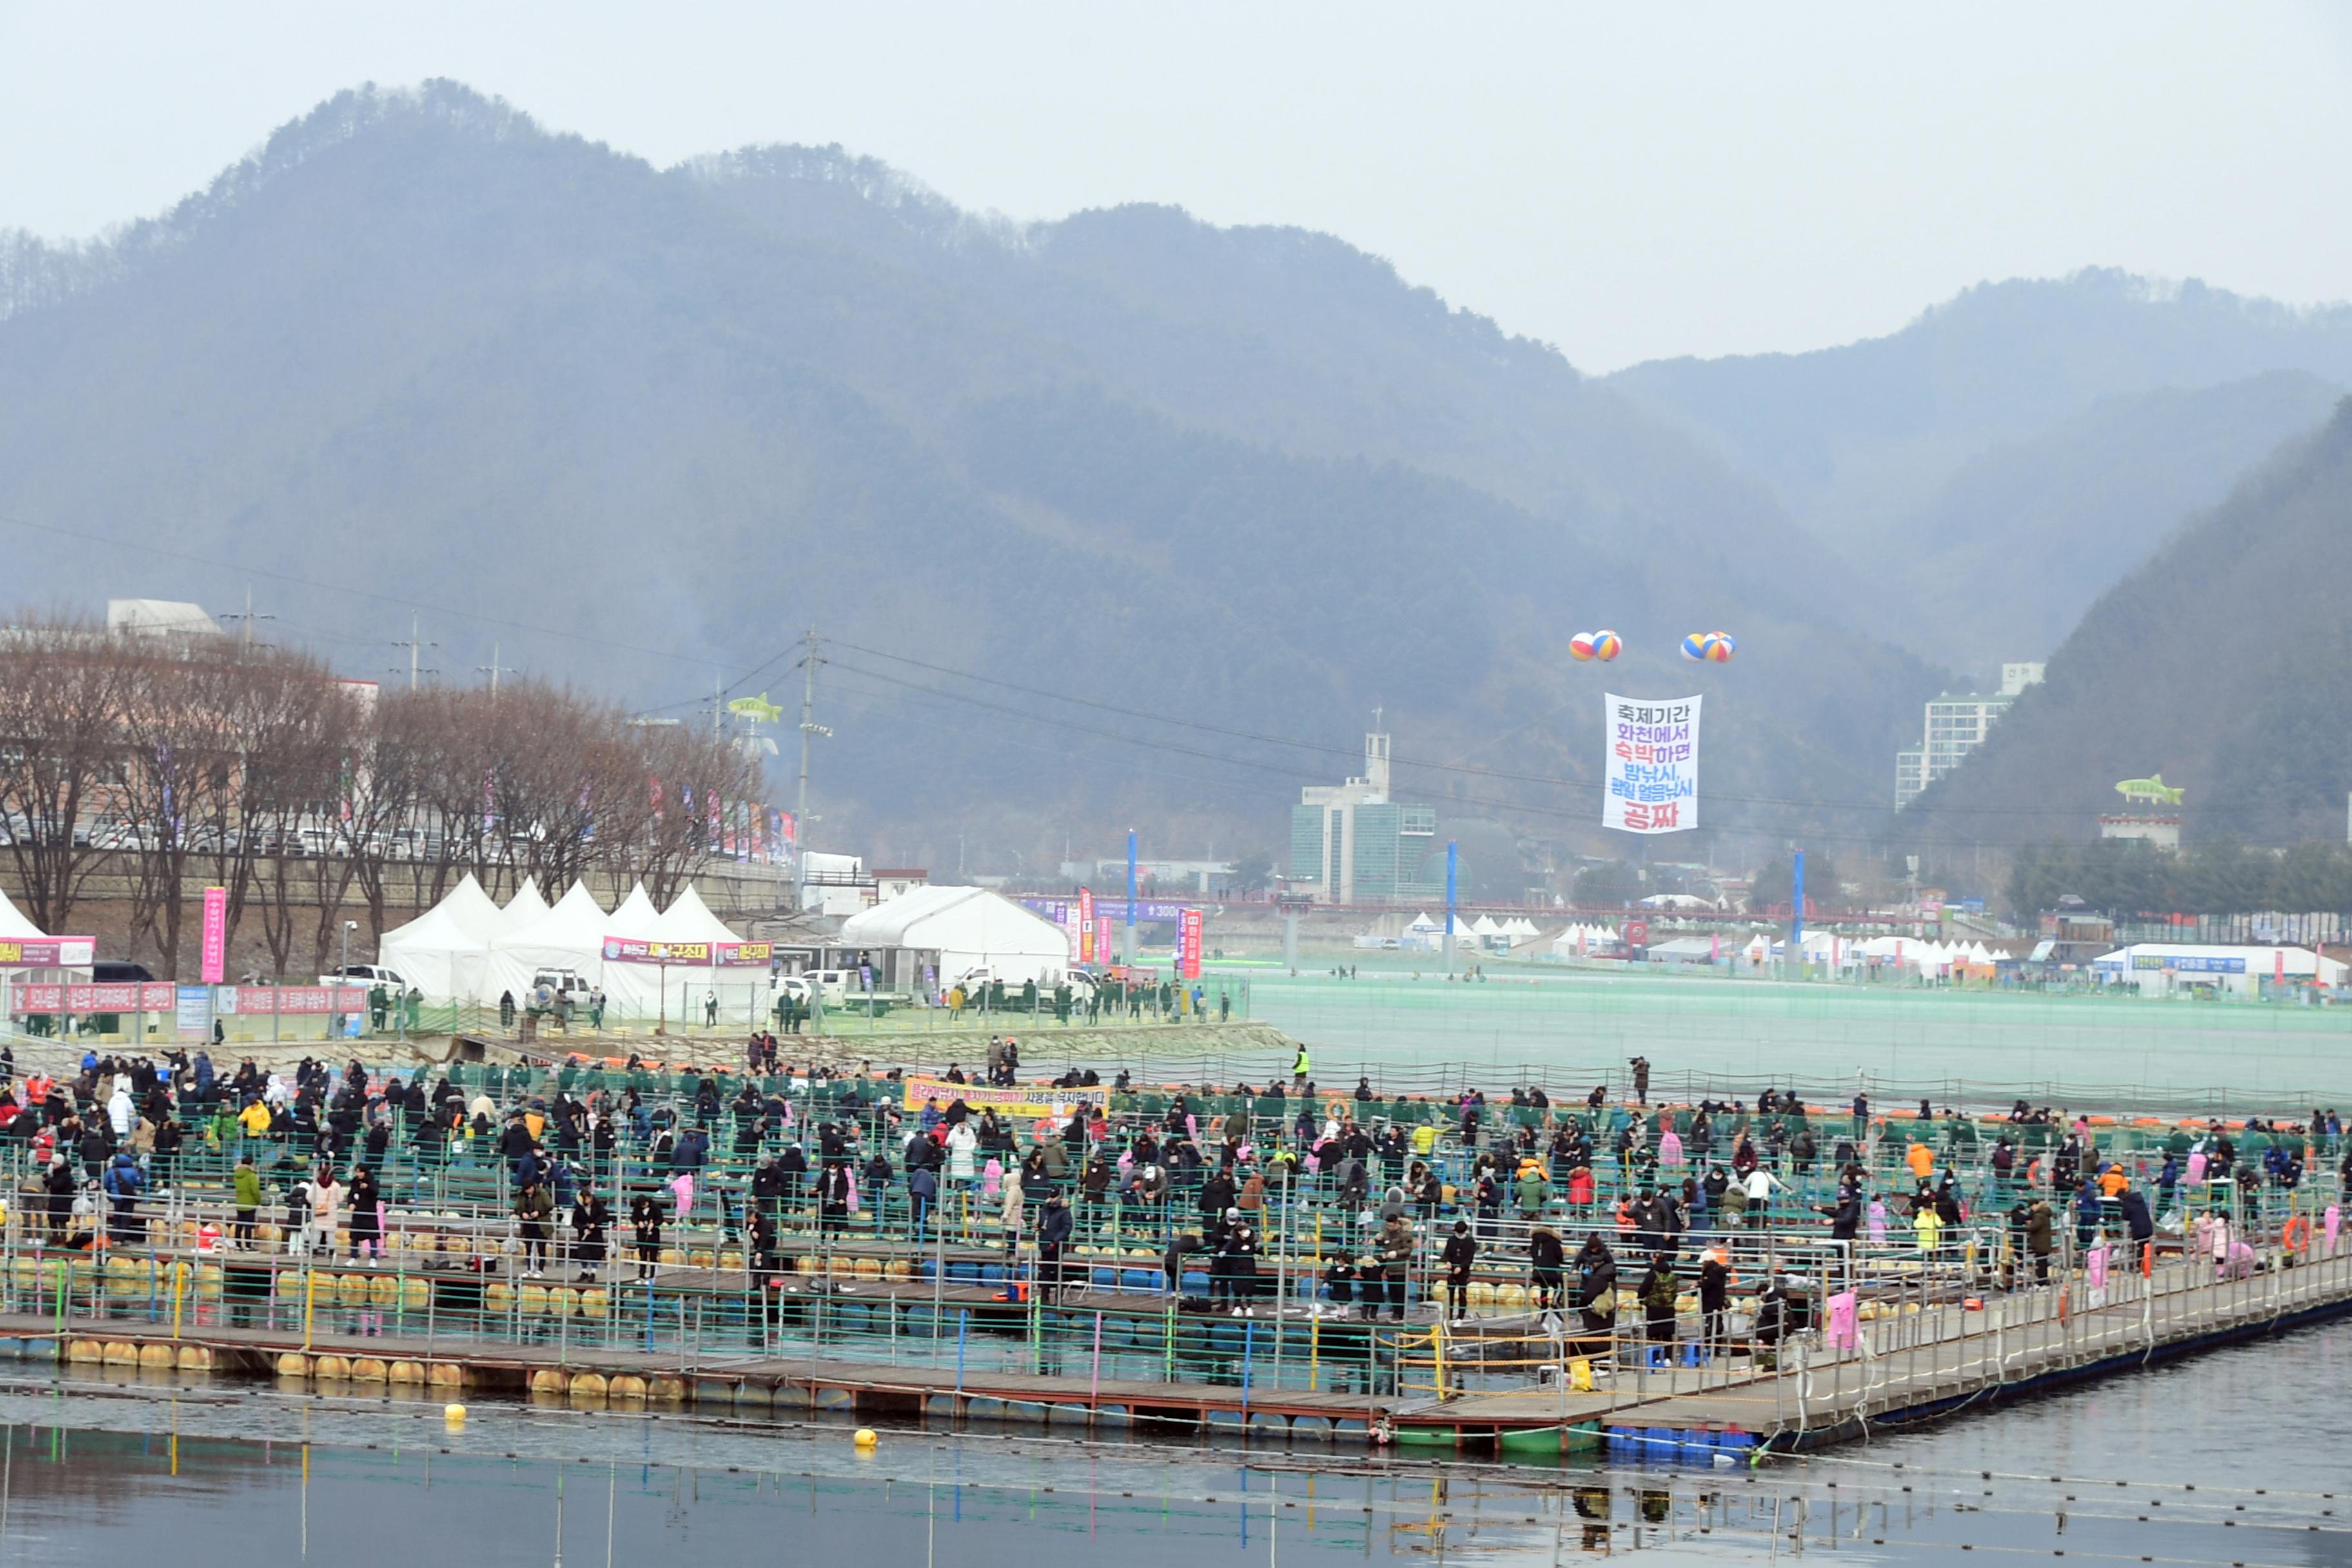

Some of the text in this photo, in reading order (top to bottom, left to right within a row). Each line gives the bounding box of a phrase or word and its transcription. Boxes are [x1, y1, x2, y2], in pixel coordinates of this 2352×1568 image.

[1618, 704, 1690, 725] 축제기간
[1617, 722, 1690, 743] 화천에서
[1615, 741, 1690, 764] 숙박하면
[1638, 778, 1692, 802] 얼음낚시
[1623, 801, 1680, 830] 공짜
[1025, 1091, 1054, 1104] 사용을
